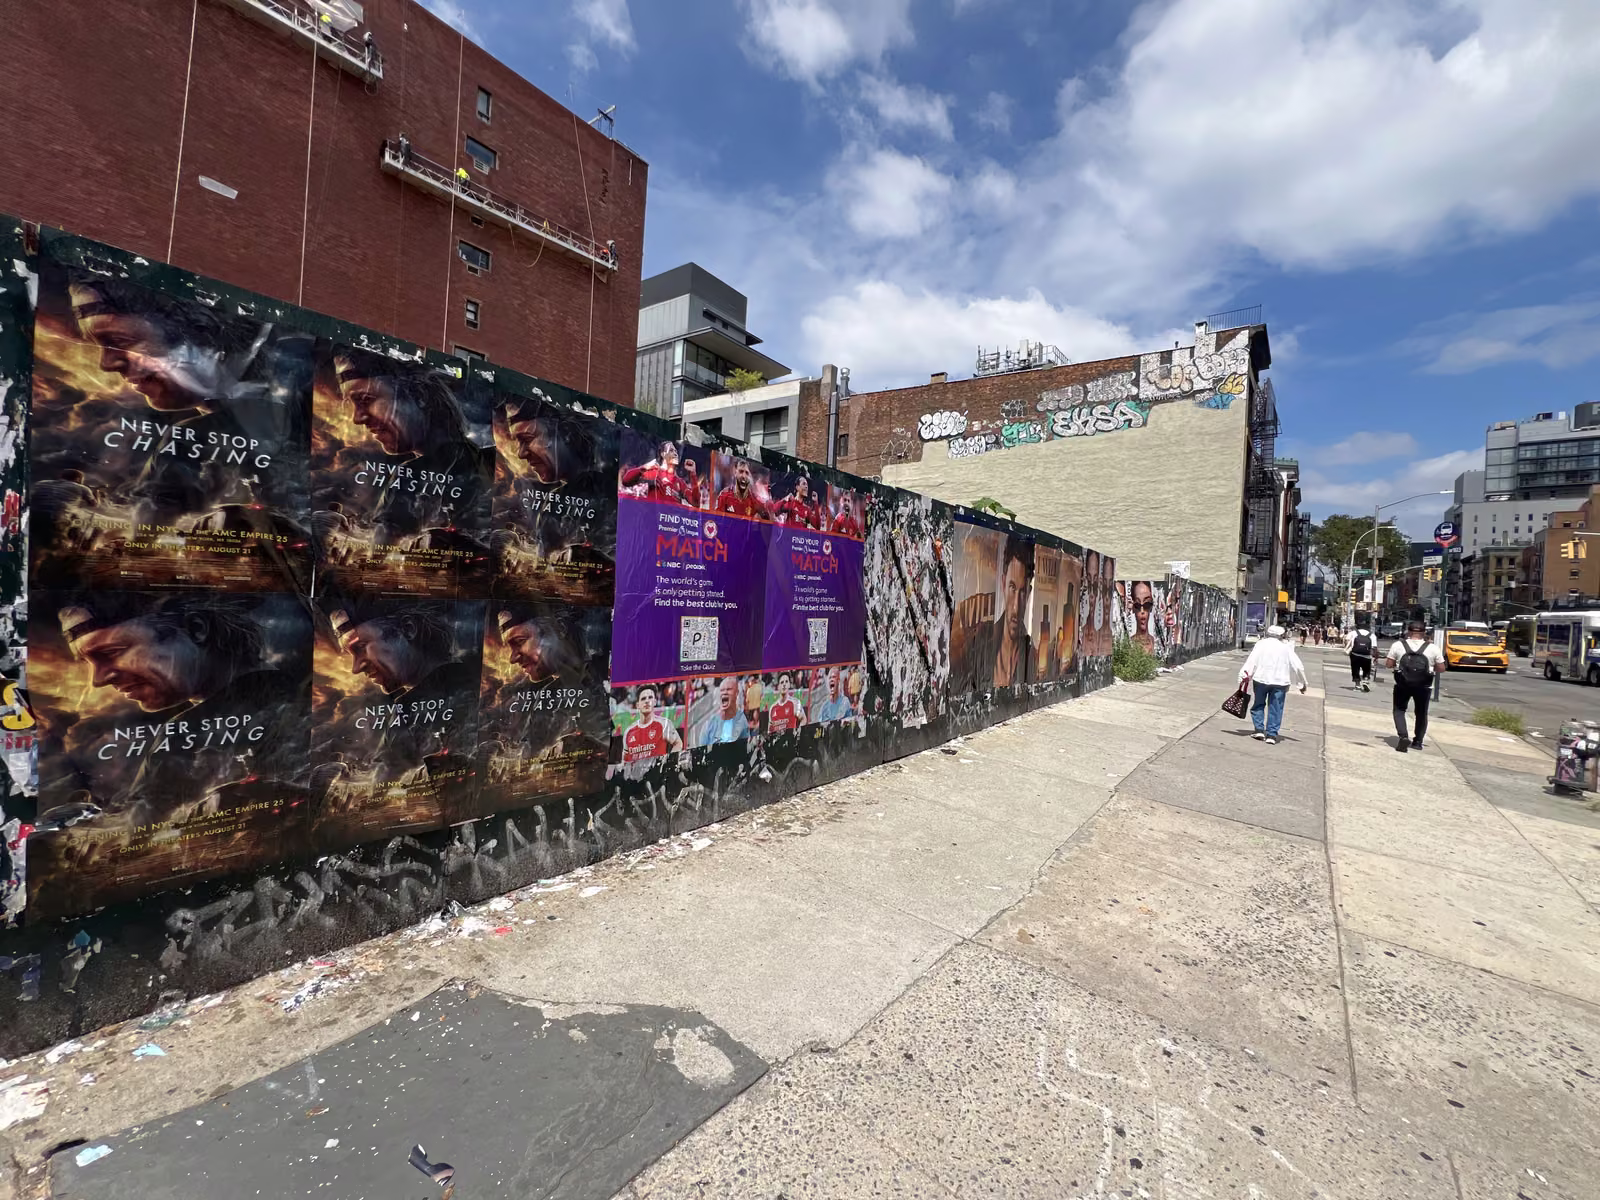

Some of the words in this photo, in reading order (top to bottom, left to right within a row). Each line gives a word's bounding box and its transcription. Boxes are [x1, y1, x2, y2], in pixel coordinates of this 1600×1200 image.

[121, 417, 196, 442] NEVER
[208, 432, 259, 450] STOP
[104, 432, 272, 469] CHASING
[365, 460, 413, 478] NEVER
[420, 470, 454, 484] STOP
[354, 472, 463, 499] CHASING
[526, 489, 561, 503] NEVER
[565, 495, 590, 507] STOP
[521, 497, 596, 519] CHASING
[658, 524, 679, 533] Premier
[660, 513, 680, 524] FIND
[681, 517, 699, 528] YOUR
[156, 525, 180, 533] NYC
[212, 529, 237, 537] AMC
[241, 530, 274, 540] EMPIRE
[276, 535, 288, 543] 25
[791, 536, 805, 544] FIND
[124, 541, 149, 549] ONLY
[208, 546, 241, 554] AUGUST
[441, 549, 463, 557] EMPIRE
[656, 533, 728, 563] MATCH
[791, 552, 839, 575] MATCH
[656, 575, 670, 584] The
[670, 577, 698, 586] world's
[655, 586, 661, 594] is
[662, 587, 677, 597] only
[677, 589, 706, 599] getting
[654, 598, 671, 607] Find
[672, 599, 685, 607] the
[686, 599, 705, 608] best
[724, 602, 738, 610] you.
[516, 689, 552, 700] NEVER
[556, 688, 583, 699] STOP
[365, 703, 404, 717] NEVR
[411, 699, 445, 712] STOP
[509, 698, 590, 713] CHASING
[114, 720, 190, 741] NEVER
[201, 714, 252, 732] STOP
[355, 708, 454, 730] CHASING
[98, 726, 266, 761] CHASING
[628, 743, 656, 755] Emirates
[133, 824, 146, 833] IN
[152, 821, 175, 831] NYC
[207, 808, 232, 819] AMC
[235, 802, 270, 814] EMPIRE
[273, 799, 285, 807] 25
[119, 843, 144, 853] ONLY
[203, 824, 235, 837] AUGUST
